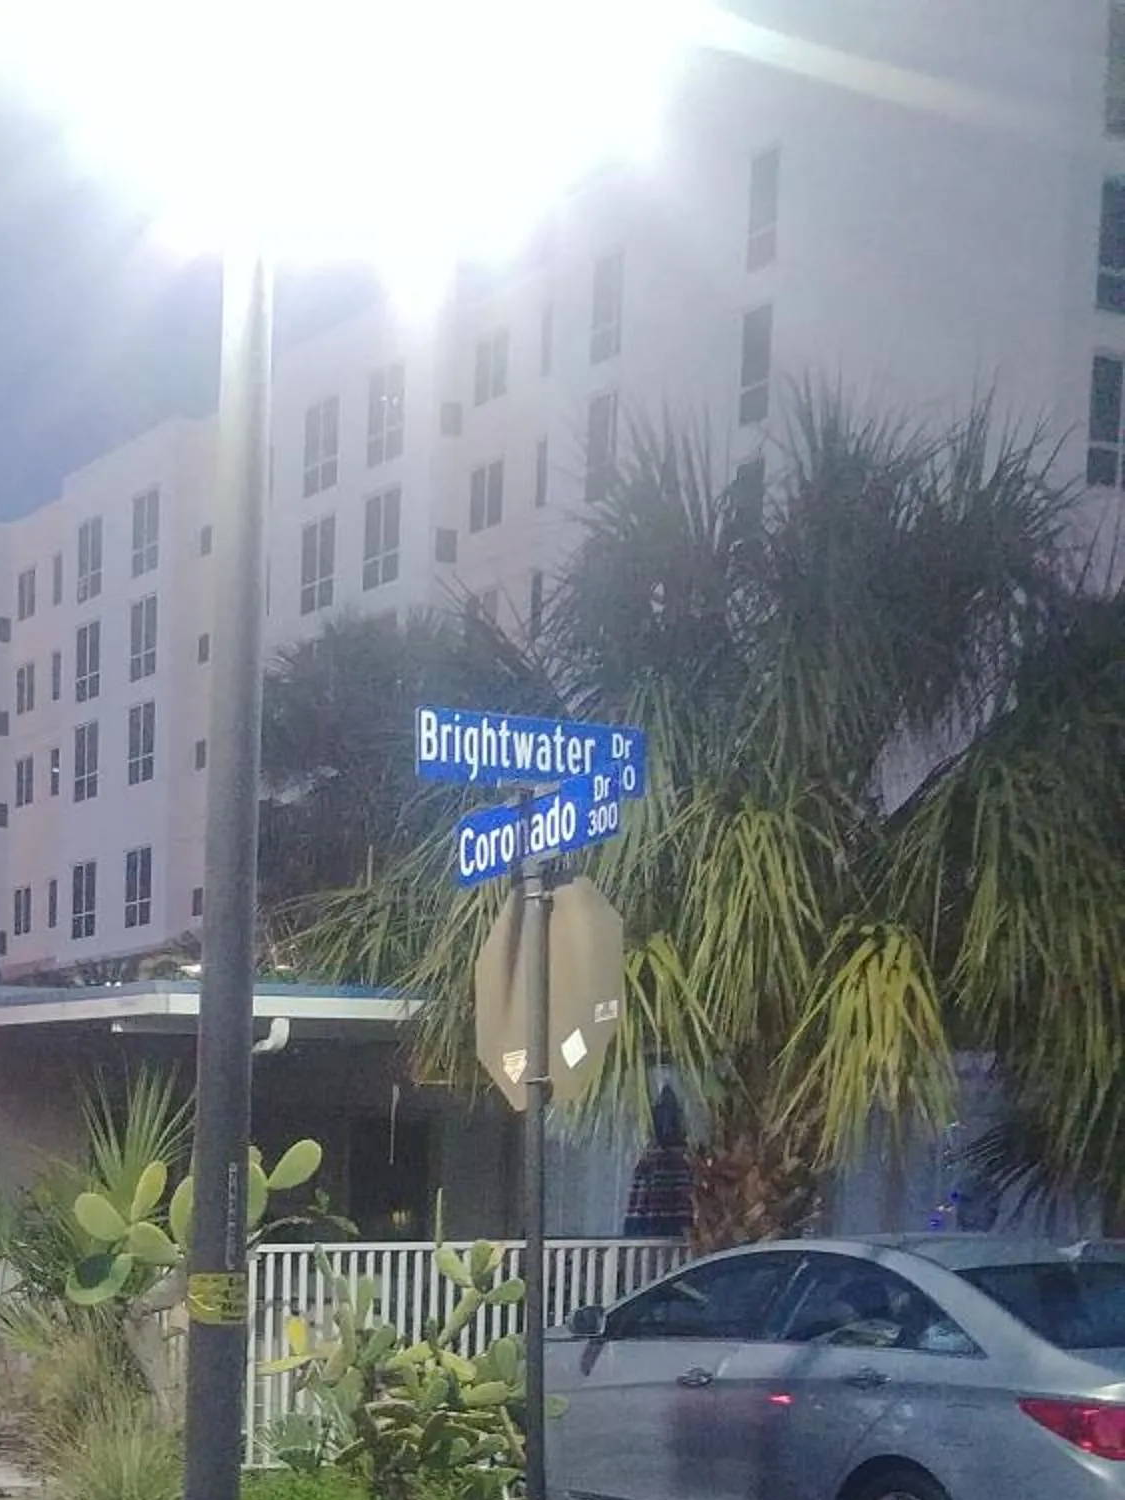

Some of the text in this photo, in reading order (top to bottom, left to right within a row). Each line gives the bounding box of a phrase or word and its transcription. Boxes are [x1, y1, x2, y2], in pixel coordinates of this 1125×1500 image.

[419, 709, 634, 781] Brightwater Dr
[459, 775, 613, 878] Coronado Dr
[587, 802, 619, 837] 300
